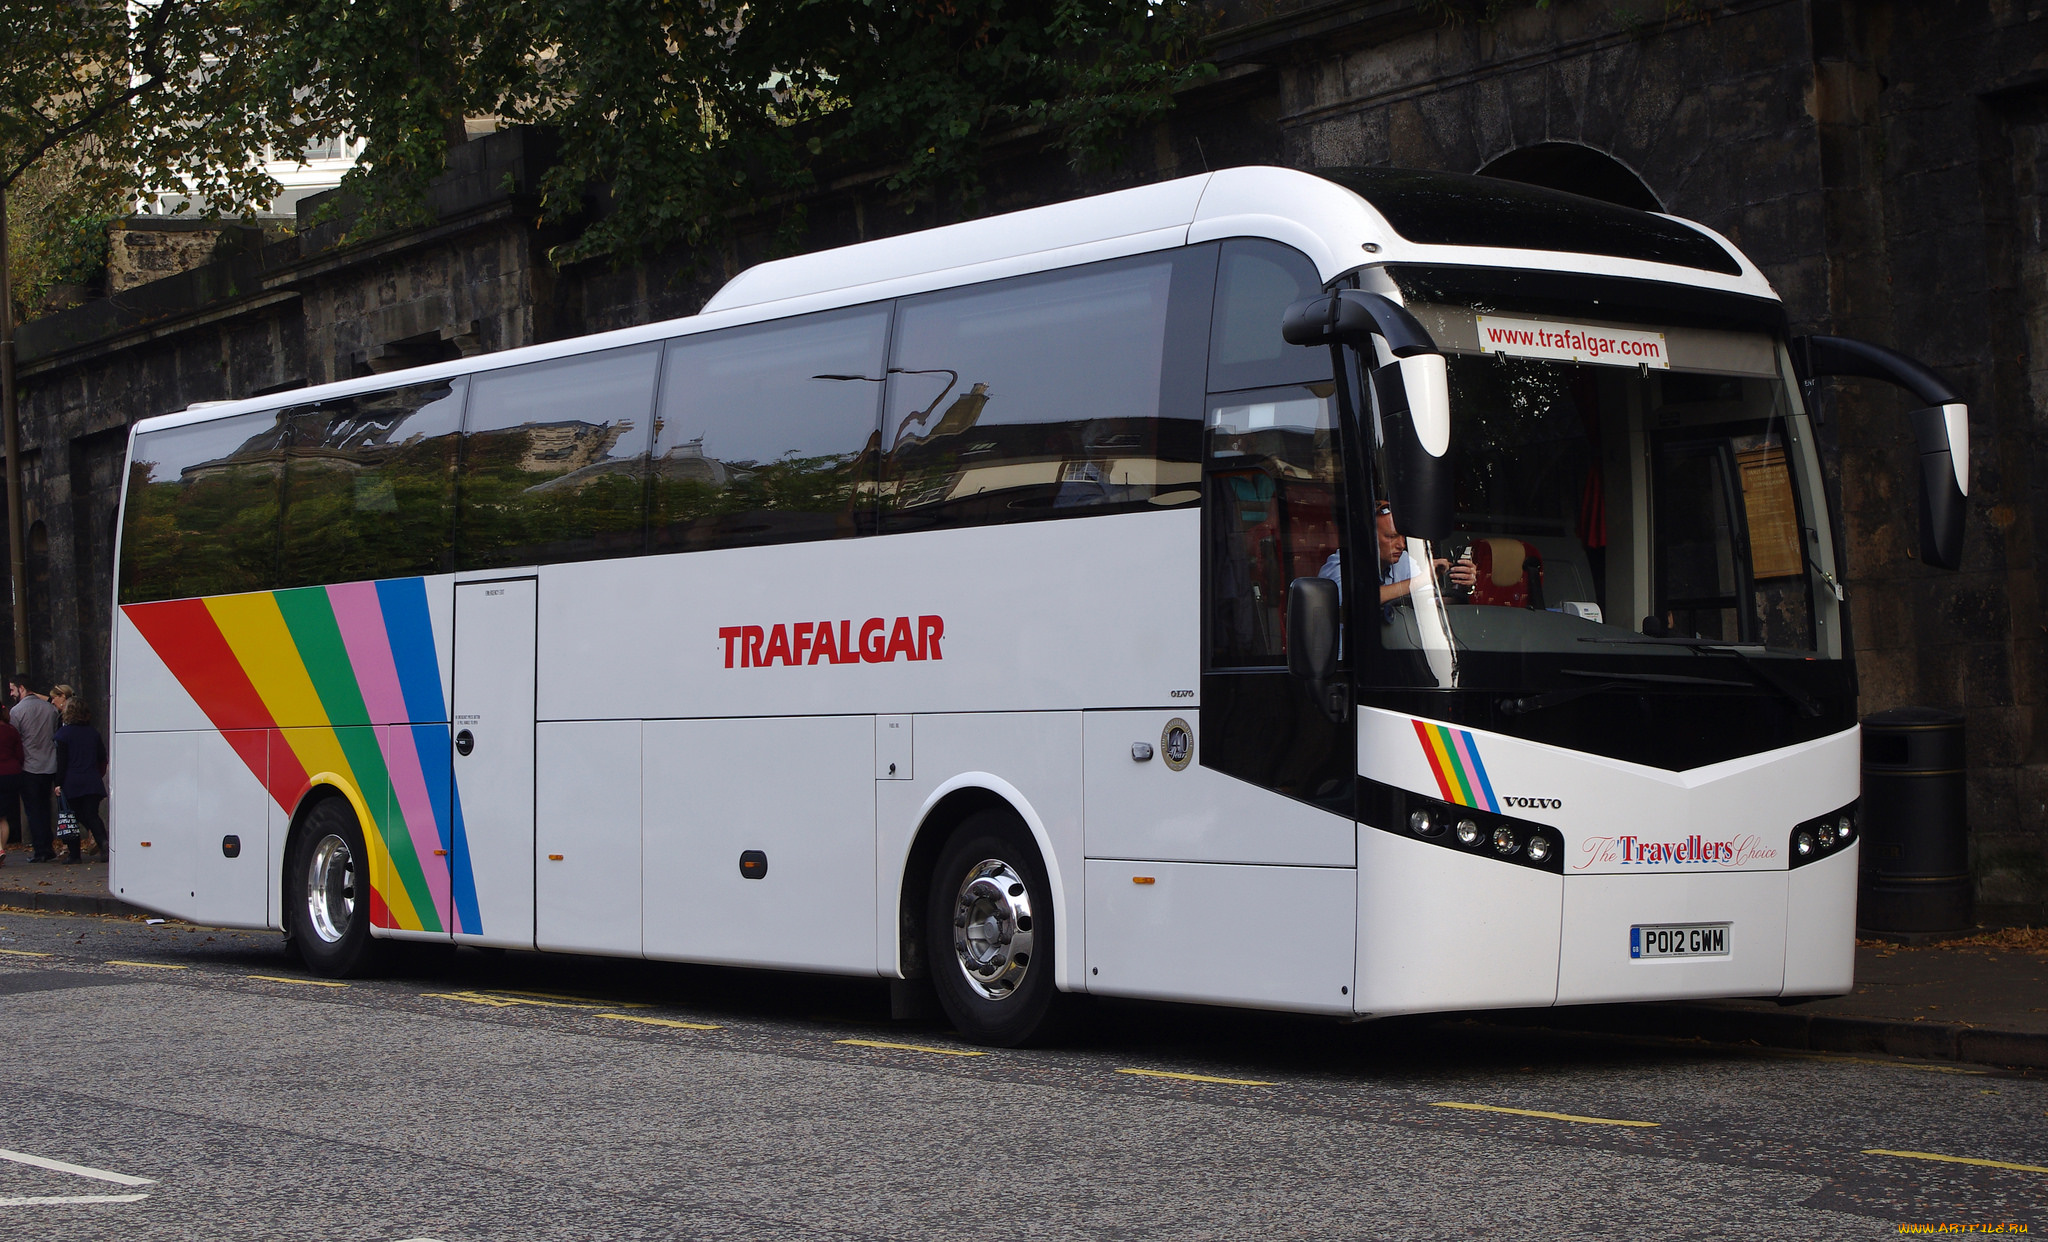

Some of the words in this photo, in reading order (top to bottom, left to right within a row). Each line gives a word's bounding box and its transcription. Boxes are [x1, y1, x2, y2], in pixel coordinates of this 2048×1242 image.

[1487, 327, 1660, 358] www.trafalgar.com
[719, 615, 944, 668] TRAFALGAR
[1503, 796, 1562, 810] VOLVO
[1573, 836, 1617, 869] The
[1617, 834, 1733, 865] Travellers
[1718, 833, 1777, 867] Choice
[1646, 930, 1685, 953] PO12
[1690, 929, 1724, 952] GWM
